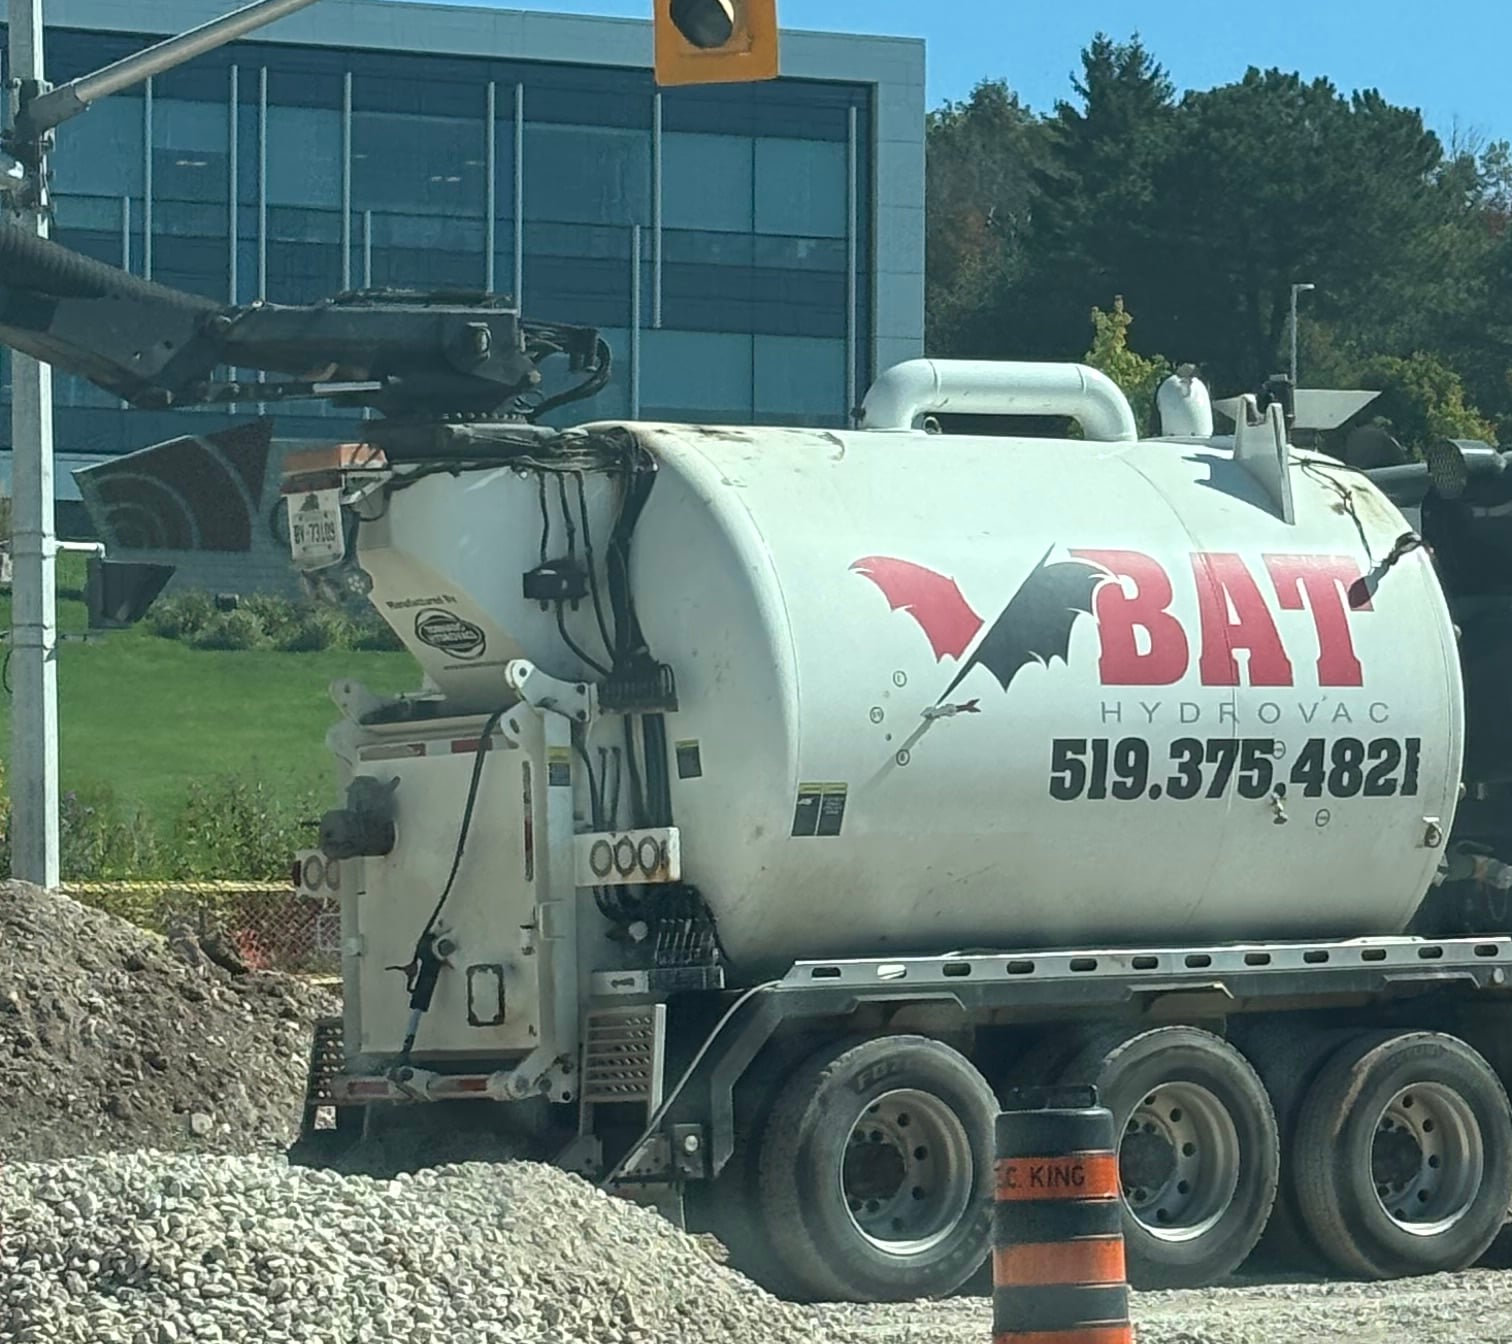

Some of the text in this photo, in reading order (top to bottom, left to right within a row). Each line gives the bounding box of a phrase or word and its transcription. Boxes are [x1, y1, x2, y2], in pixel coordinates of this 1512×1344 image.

[1069, 548, 1374, 687] BAT
[1100, 701, 1390, 724] HYDROVAC
[1049, 737, 1422, 801] 519.375.4821
[1030, 1165, 1085, 1187] KING
